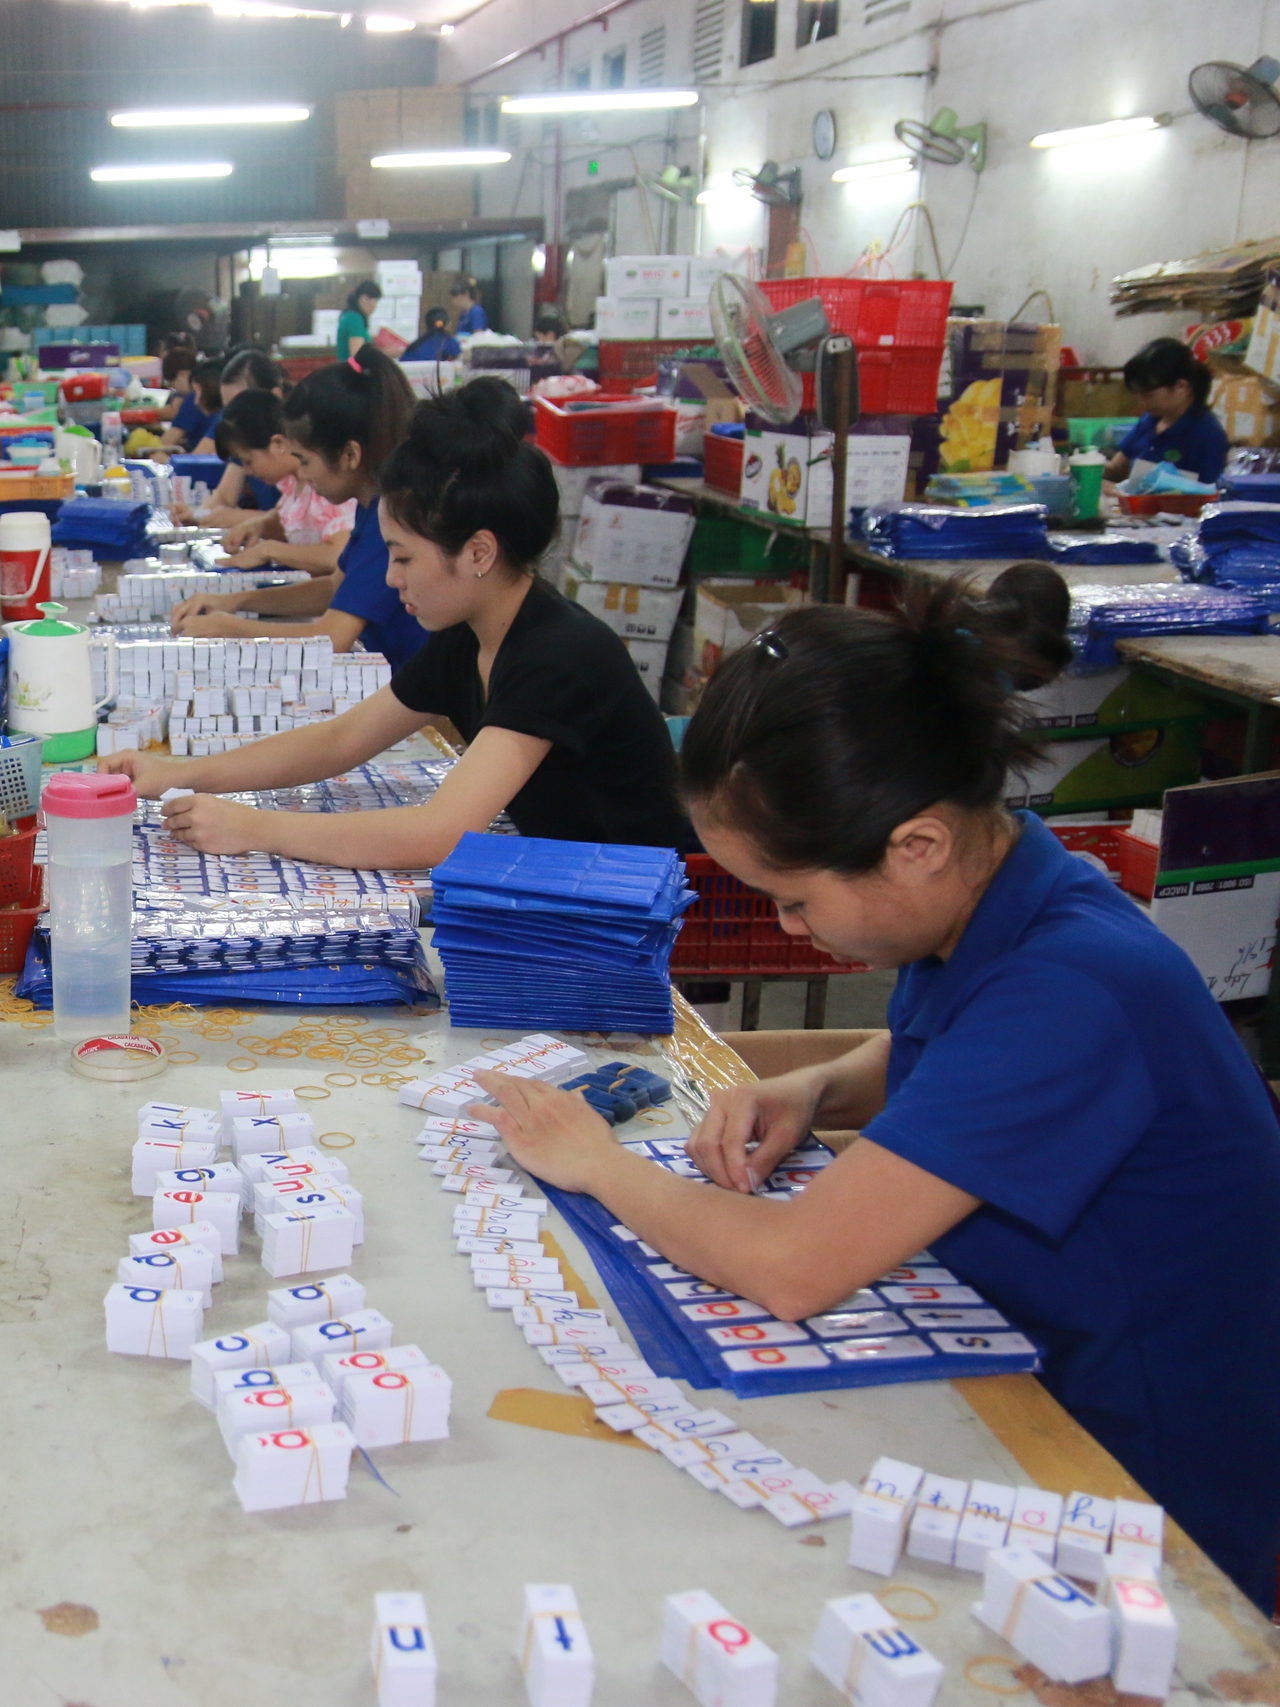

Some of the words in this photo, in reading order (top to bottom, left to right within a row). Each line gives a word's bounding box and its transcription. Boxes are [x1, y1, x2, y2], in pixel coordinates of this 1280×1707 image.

[150, 1119, 190, 1130] k
[174, 1168, 216, 1182] g
[163, 1190, 204, 1204] ê
[296, 1193, 326, 1204] s
[150, 1230, 183, 1244] e
[215, 1335, 250, 1352] c
[338, 1352, 387, 1369] ô
[749, 1347, 787, 1365] a
[233, 1369, 276, 1388] b
[372, 1372, 410, 1390] o
[243, 1388, 293, 1407] â
[257, 1429, 310, 1450] ă
[552, 1615, 575, 1653] t
